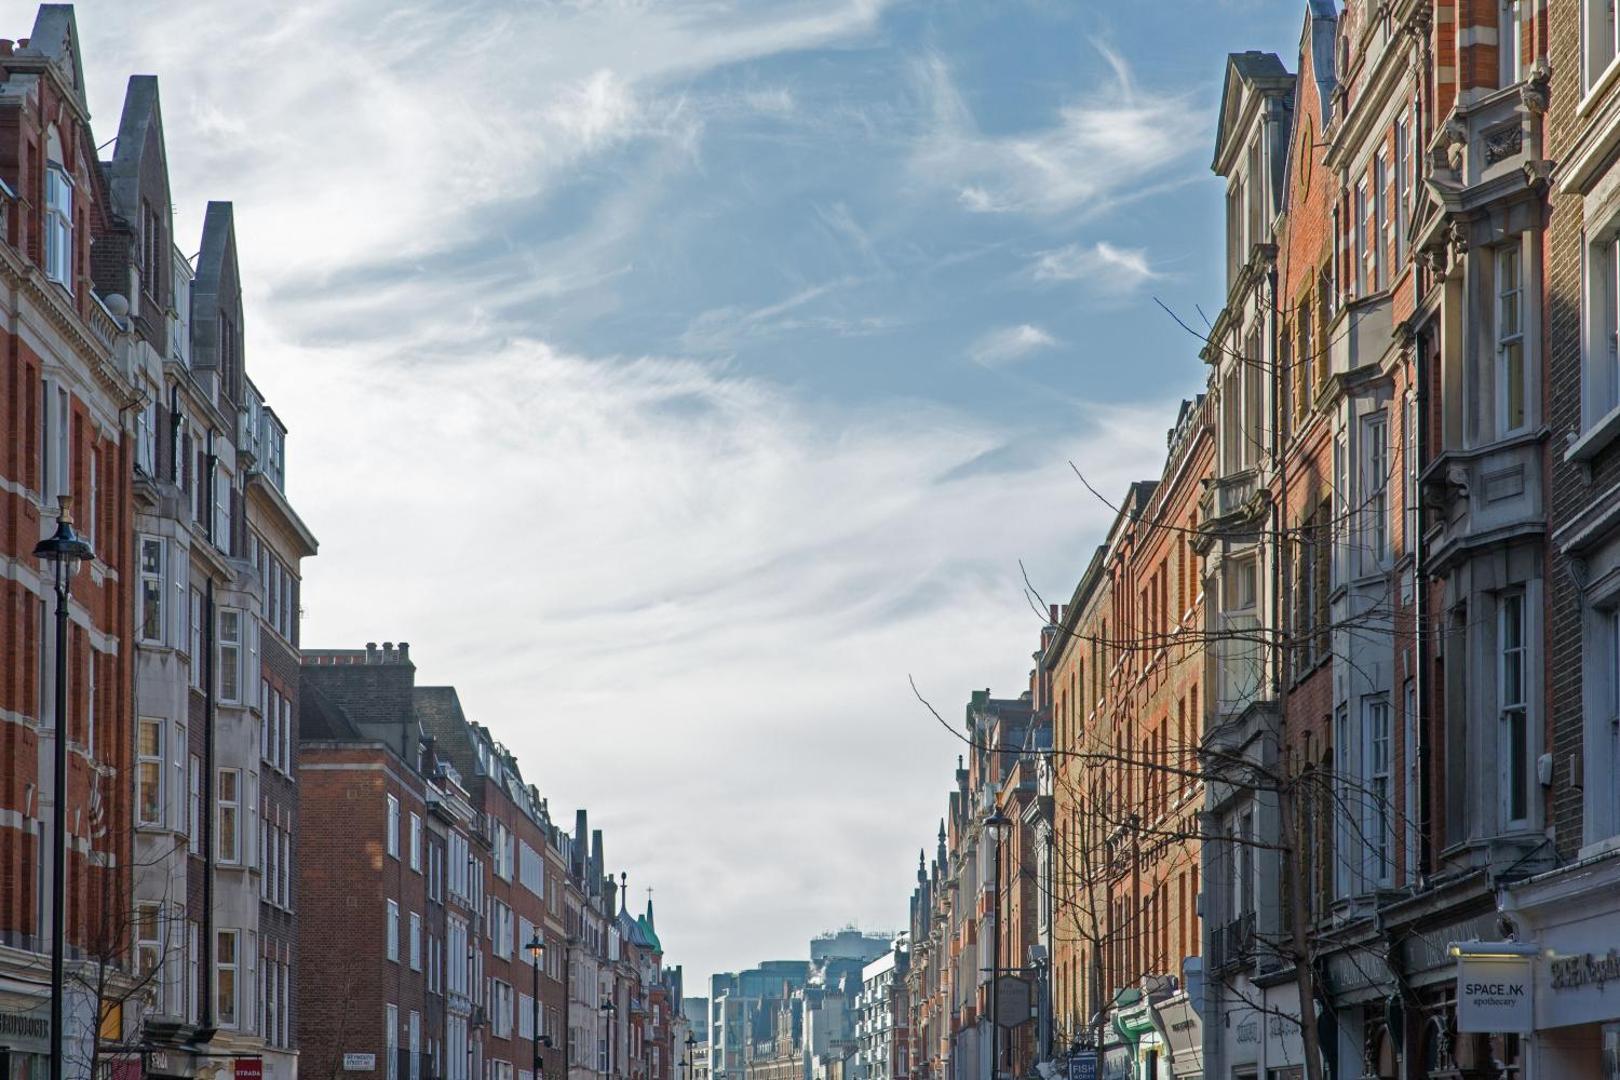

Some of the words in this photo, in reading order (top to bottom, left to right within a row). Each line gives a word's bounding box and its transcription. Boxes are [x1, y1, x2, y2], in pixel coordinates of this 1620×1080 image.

[1465, 983, 1524, 997] SPACE.NK
[1473, 997, 1516, 1007] apothecary
[1073, 1065, 1095, 1073] FISH
